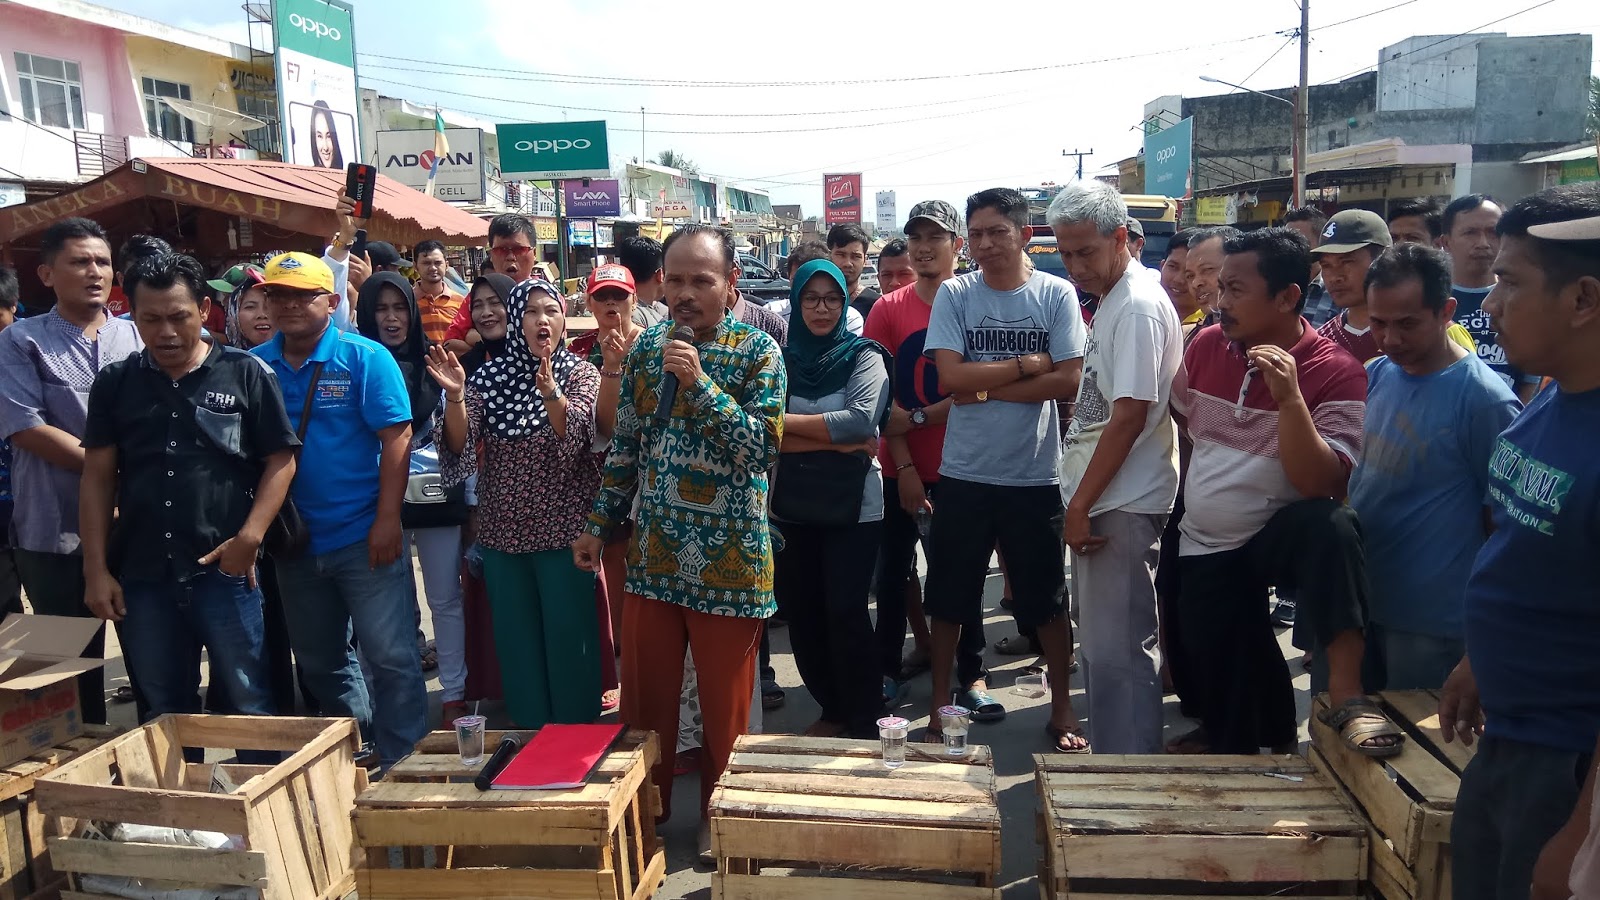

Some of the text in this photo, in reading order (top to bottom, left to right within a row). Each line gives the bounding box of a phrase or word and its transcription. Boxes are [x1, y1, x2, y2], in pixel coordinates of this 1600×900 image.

[289, 13, 342, 41] oppo
[286, 61, 301, 83] F7
[514, 138, 592, 154] oppo
[1156, 145, 1176, 164] oppo
[439, 187, 466, 195] CELL
[573, 191, 610, 200] LAVA
[10, 175, 281, 233] ANEKA BUAH
[205, 391, 236, 405] PRH
